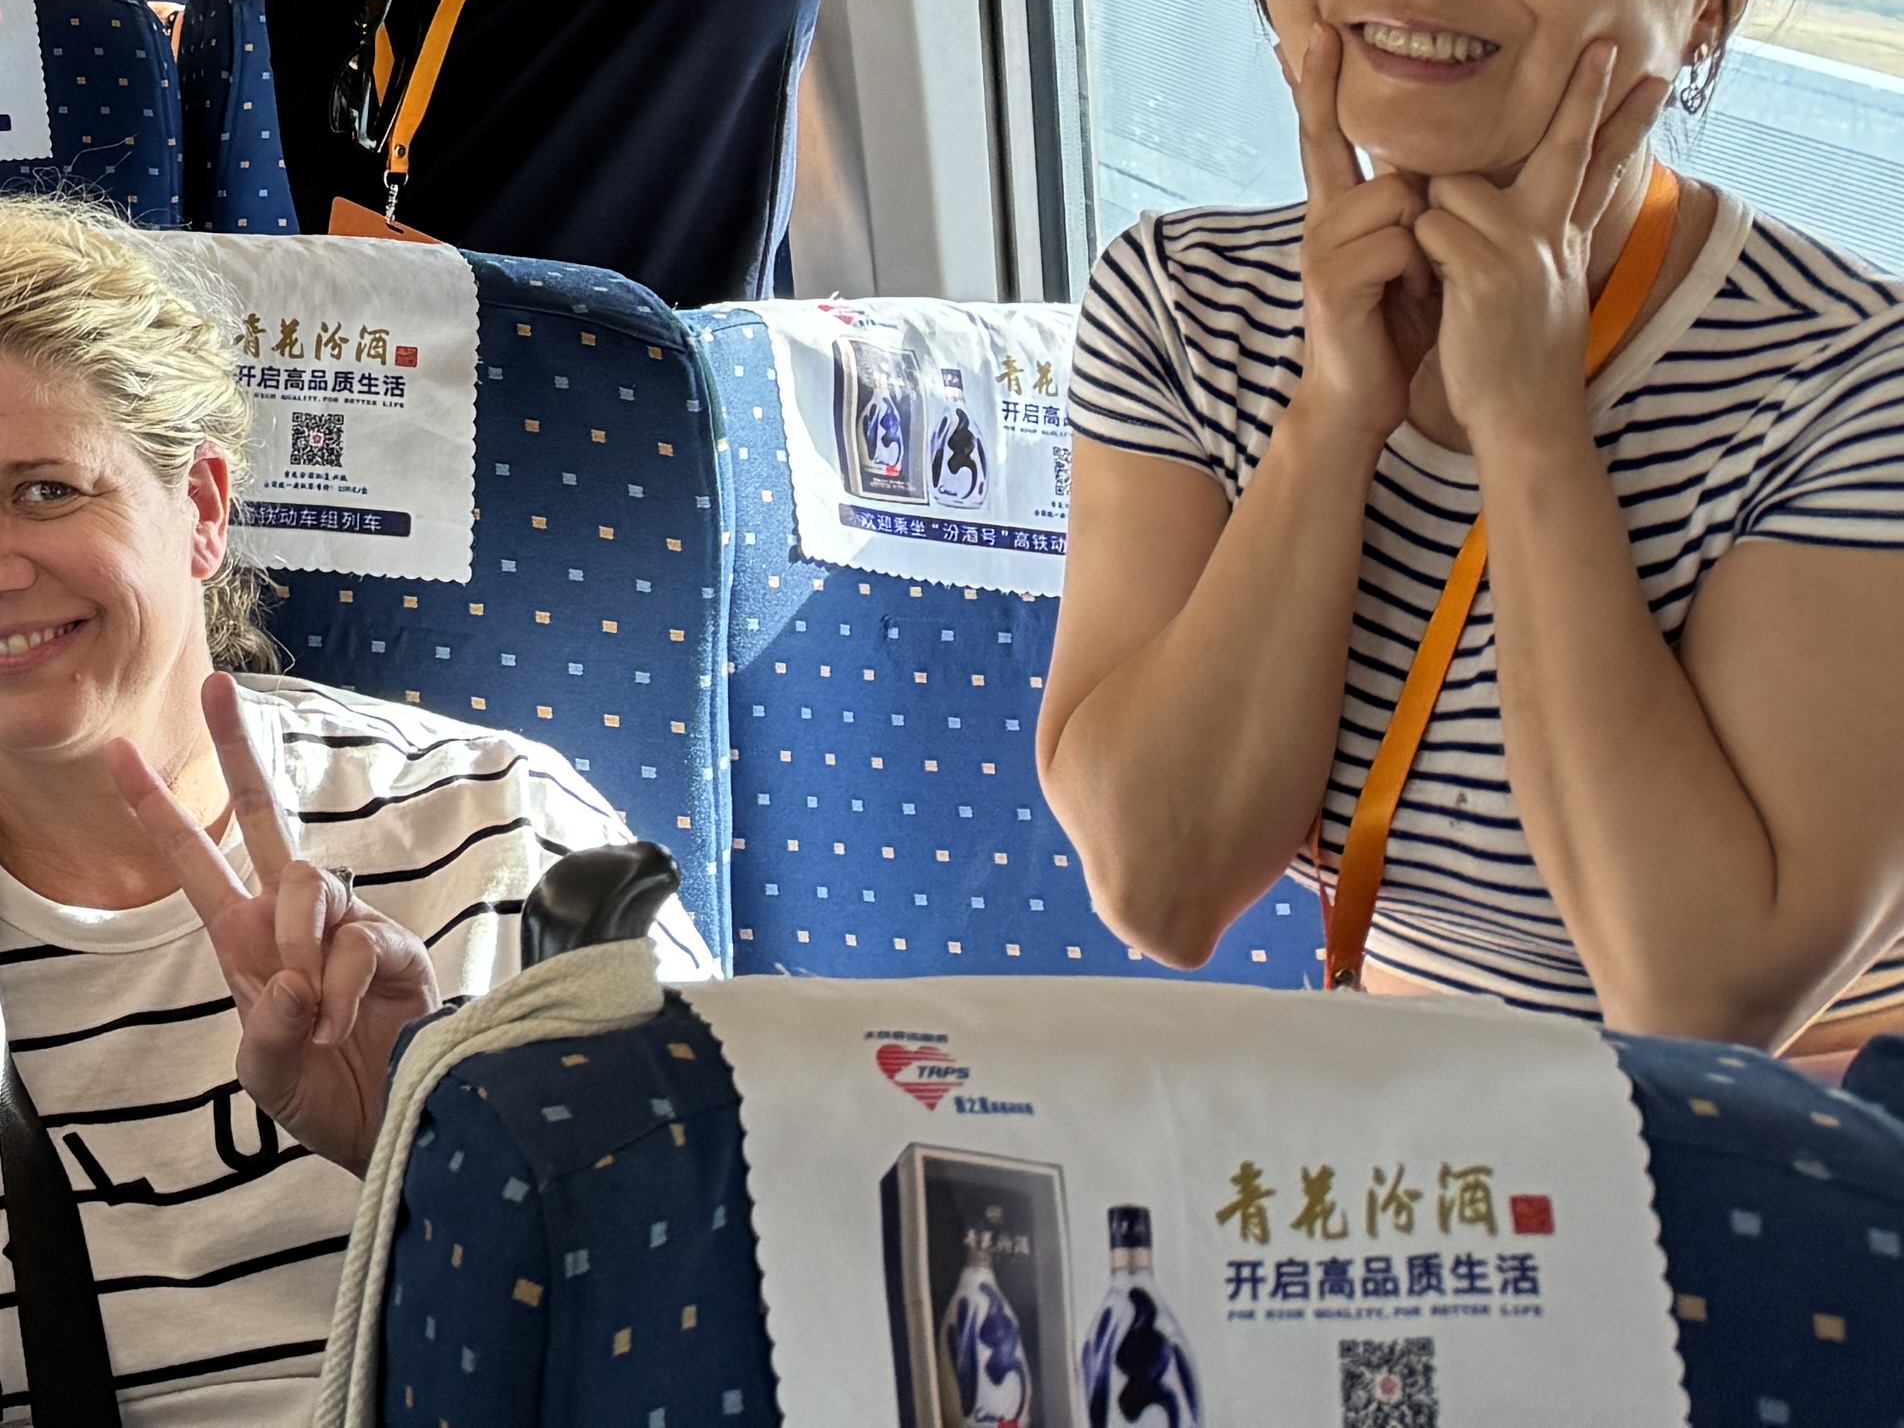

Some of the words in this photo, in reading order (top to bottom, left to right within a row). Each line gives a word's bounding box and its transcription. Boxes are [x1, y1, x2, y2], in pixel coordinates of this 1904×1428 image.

[233, 313, 389, 365] 青花汾酒
[238, 365, 406, 397] 开启高品质生活
[1002, 400, 1071, 428] 开启高
[916, 1065, 971, 1080] TRPS
[1215, 1159, 1499, 1247] 青花汾酒
[1224, 1251, 1541, 1302] 开启高品质生活
